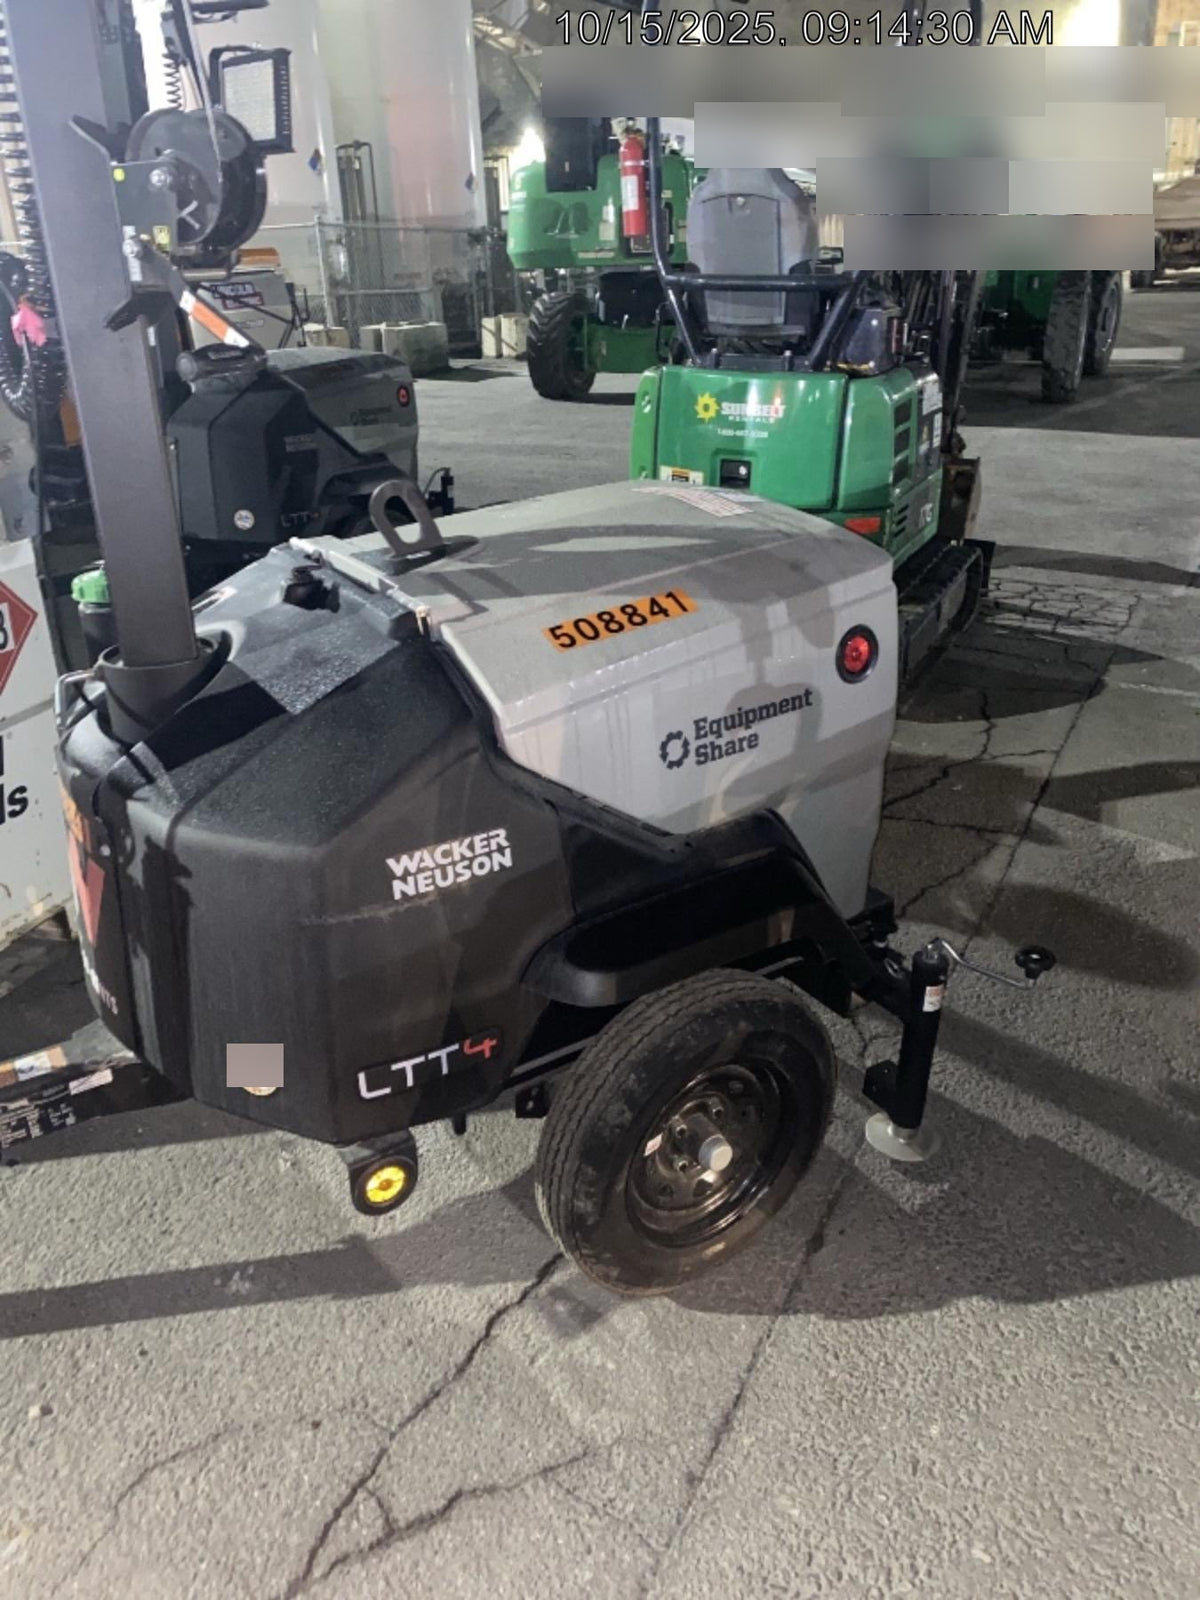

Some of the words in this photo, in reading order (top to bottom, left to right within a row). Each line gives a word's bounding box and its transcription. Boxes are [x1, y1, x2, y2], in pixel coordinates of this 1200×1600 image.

[549, 591, 688, 648] 508841
[693, 688, 813, 739] Equipment
[695, 732, 760, 766] Share
[385, 828, 510, 877] WACKER
[392, 848, 512, 900] NEUSON
[358, 1038, 497, 1099] LTT4
